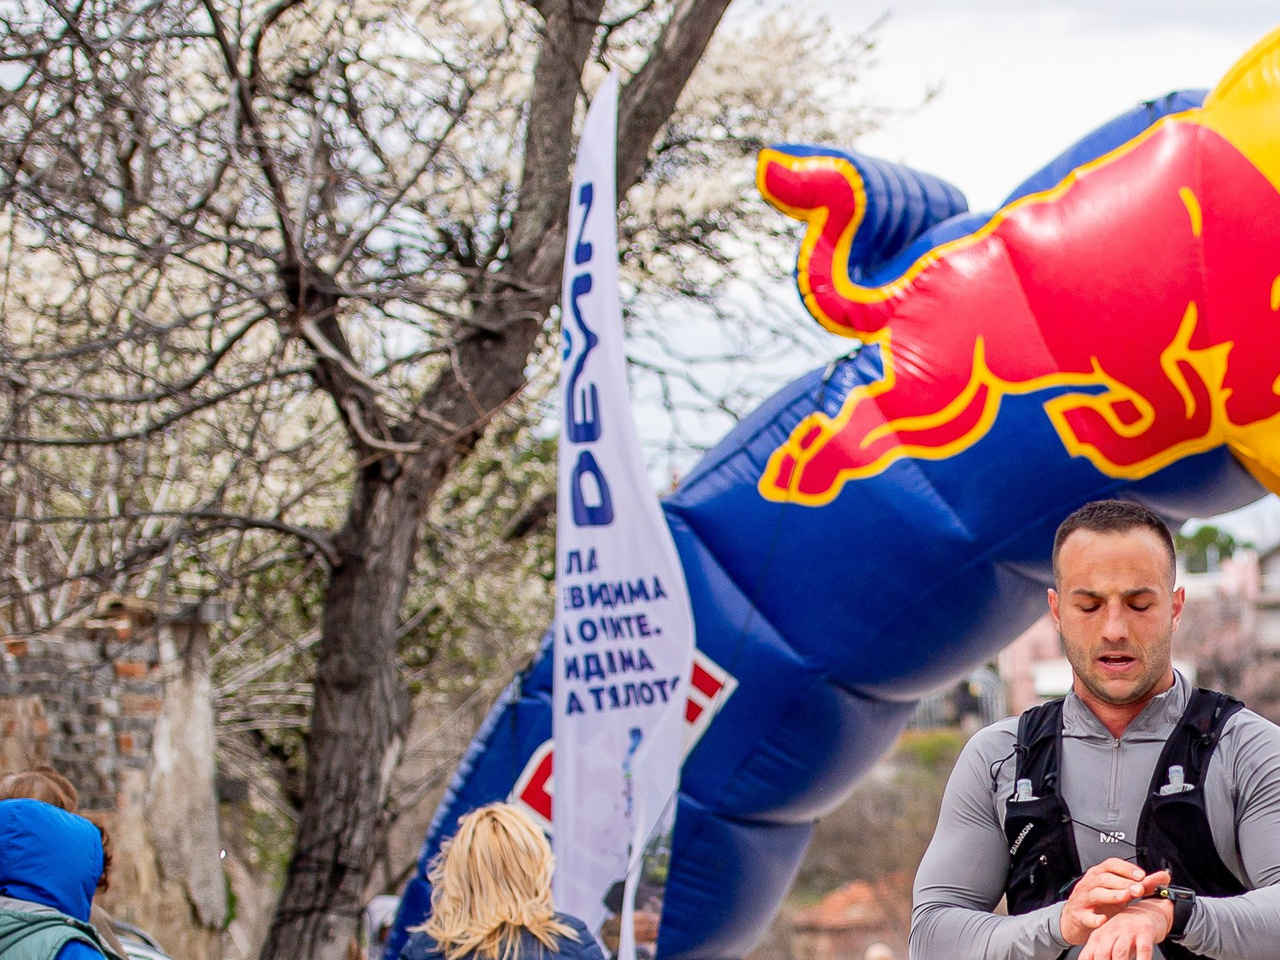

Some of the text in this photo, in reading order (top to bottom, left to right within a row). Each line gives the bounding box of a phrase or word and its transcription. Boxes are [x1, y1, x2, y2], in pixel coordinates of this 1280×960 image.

[563, 182, 613, 527] DEVIN
[564, 576, 667, 609] ВИДИМА
[1010, 822, 1034, 856] SALOMON
